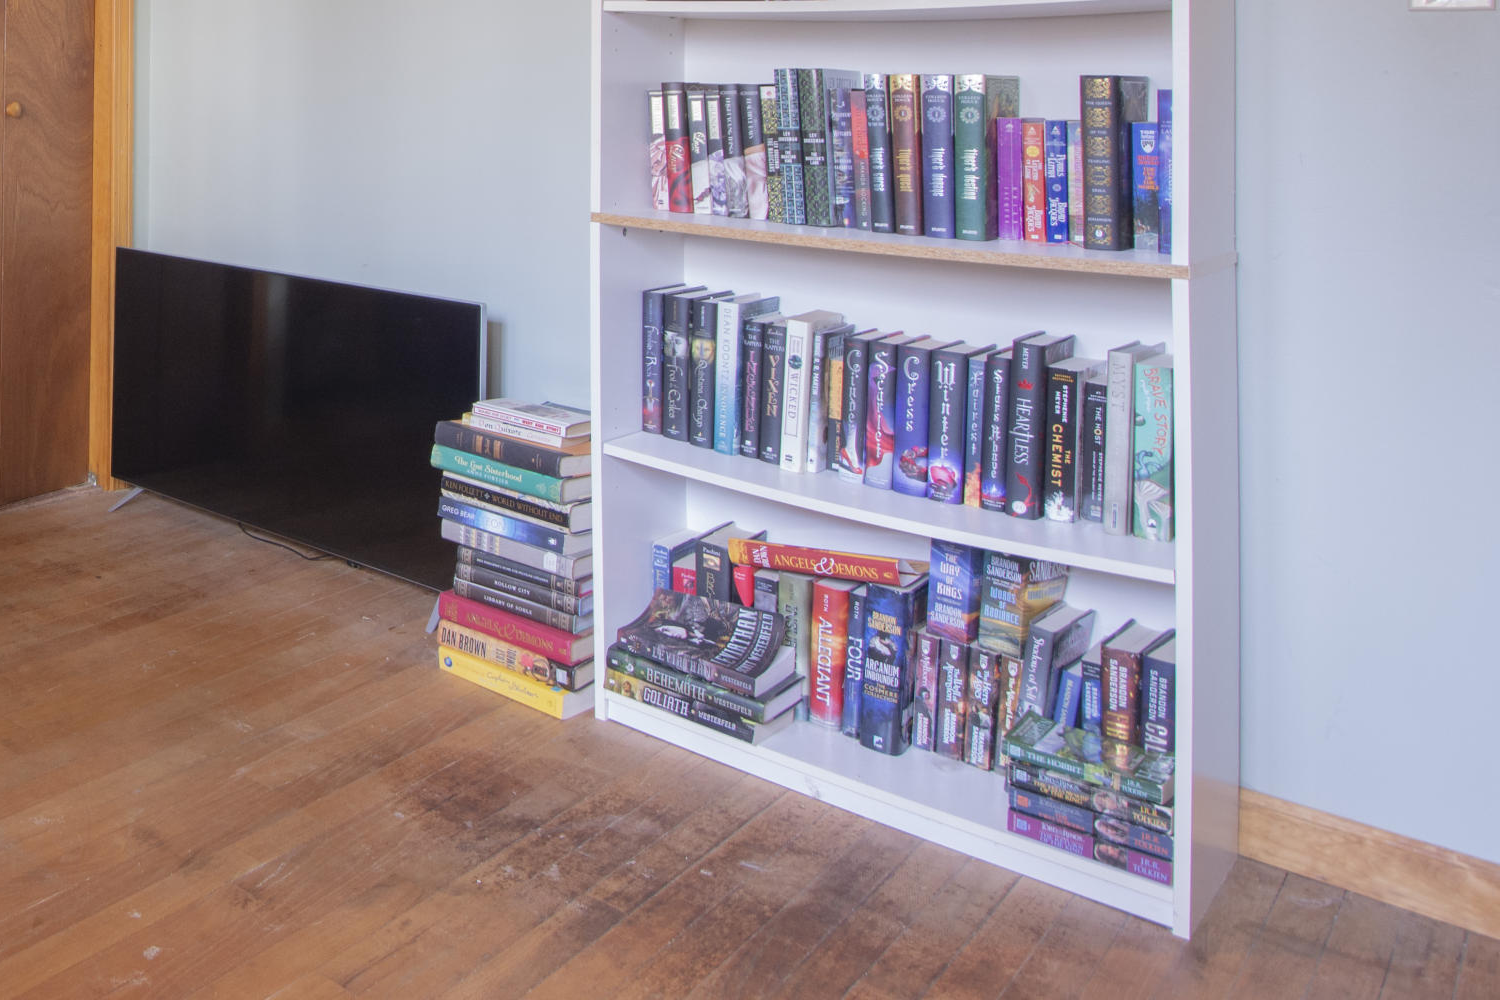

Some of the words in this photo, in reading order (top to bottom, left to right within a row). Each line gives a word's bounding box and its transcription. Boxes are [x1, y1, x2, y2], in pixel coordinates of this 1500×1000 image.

[1049, 197, 1059, 226] JACQUES
[723, 308, 733, 334] DEAN
[787, 372, 799, 420] WICKED
[903, 356, 920, 432] Cress
[1110, 361, 1127, 413] MYST
[1143, 367, 1169, 410] BRAVE
[934, 360, 956, 459] Winter
[1061, 384, 1069, 424] STEPHENIE
[1008, 397, 1035, 466] HEARTLESS
[1094, 424, 1103, 446] HOST
[1152, 411, 1171, 457] STORY
[1051, 423, 1063, 488] CHEMIST
[454, 456, 468, 467] The
[470, 460, 483, 472] Lost
[484, 463, 522, 482] Sisterhood
[441, 504, 459, 516] GREG
[460, 509, 475, 521] BEAR
[445, 480, 458, 491] KEN
[458, 483, 484, 498] FOLLETT
[491, 494, 515, 508] WORLD
[517, 500, 548, 518] WITHOUT
[548, 510, 563, 523] END
[774, 554, 816, 570] ANGELS
[813, 556, 835, 576] &
[831, 563, 879, 580] DEMONS
[940, 561, 963, 577] WAY
[945, 553, 958, 564] THE
[991, 555, 1019, 570] BRANDON
[946, 577, 954, 585] OF
[986, 564, 1022, 583] SANDERSON
[494, 580, 516, 592] HOLLOW
[518, 585, 530, 596] CITY
[936, 584, 963, 600] KINGS
[484, 595, 505, 607] LIBRARY
[506, 601, 514, 609] OF
[934, 602, 962, 619] BRANDON
[868, 617, 902, 636] SANDERSON
[872, 611, 897, 624] BRANDON
[930, 612, 965, 630] SANDERSON
[441, 627, 457, 647] DAN
[459, 633, 487, 659] BROWN
[466, 612, 499, 633] ANGELS
[515, 627, 554, 650] DEMONS
[816, 616, 833, 707] ALLEGIANT
[847, 635, 863, 681] FOUR
[865, 657, 900, 677] ARCANUM
[720, 673, 752, 691] WESTERFELD
[864, 669, 899, 688] UNBOUNDED
[1028, 673, 1036, 684] of
[1109, 658, 1118, 711] SANDERSON
[1119, 666, 1128, 708] BRANDON
[646, 668, 706, 700] BEHEMOTH
[713, 695, 753, 717] WESTERFELD
[982, 680, 992, 705] Hero
[1026, 683, 1038, 701] Self
[1148, 669, 1158, 721] SANDERSON
[1157, 677, 1167, 719] BRANDON
[643, 687, 690, 717] GOLIATH
[698, 710, 737, 731] WESTERFELD
[1026, 751, 1045, 764] THE
[1046, 757, 1082, 775] HOBBIT
[1133, 813, 1168, 829] TOLKIEN
[1133, 863, 1168, 882] TOLKIEN
